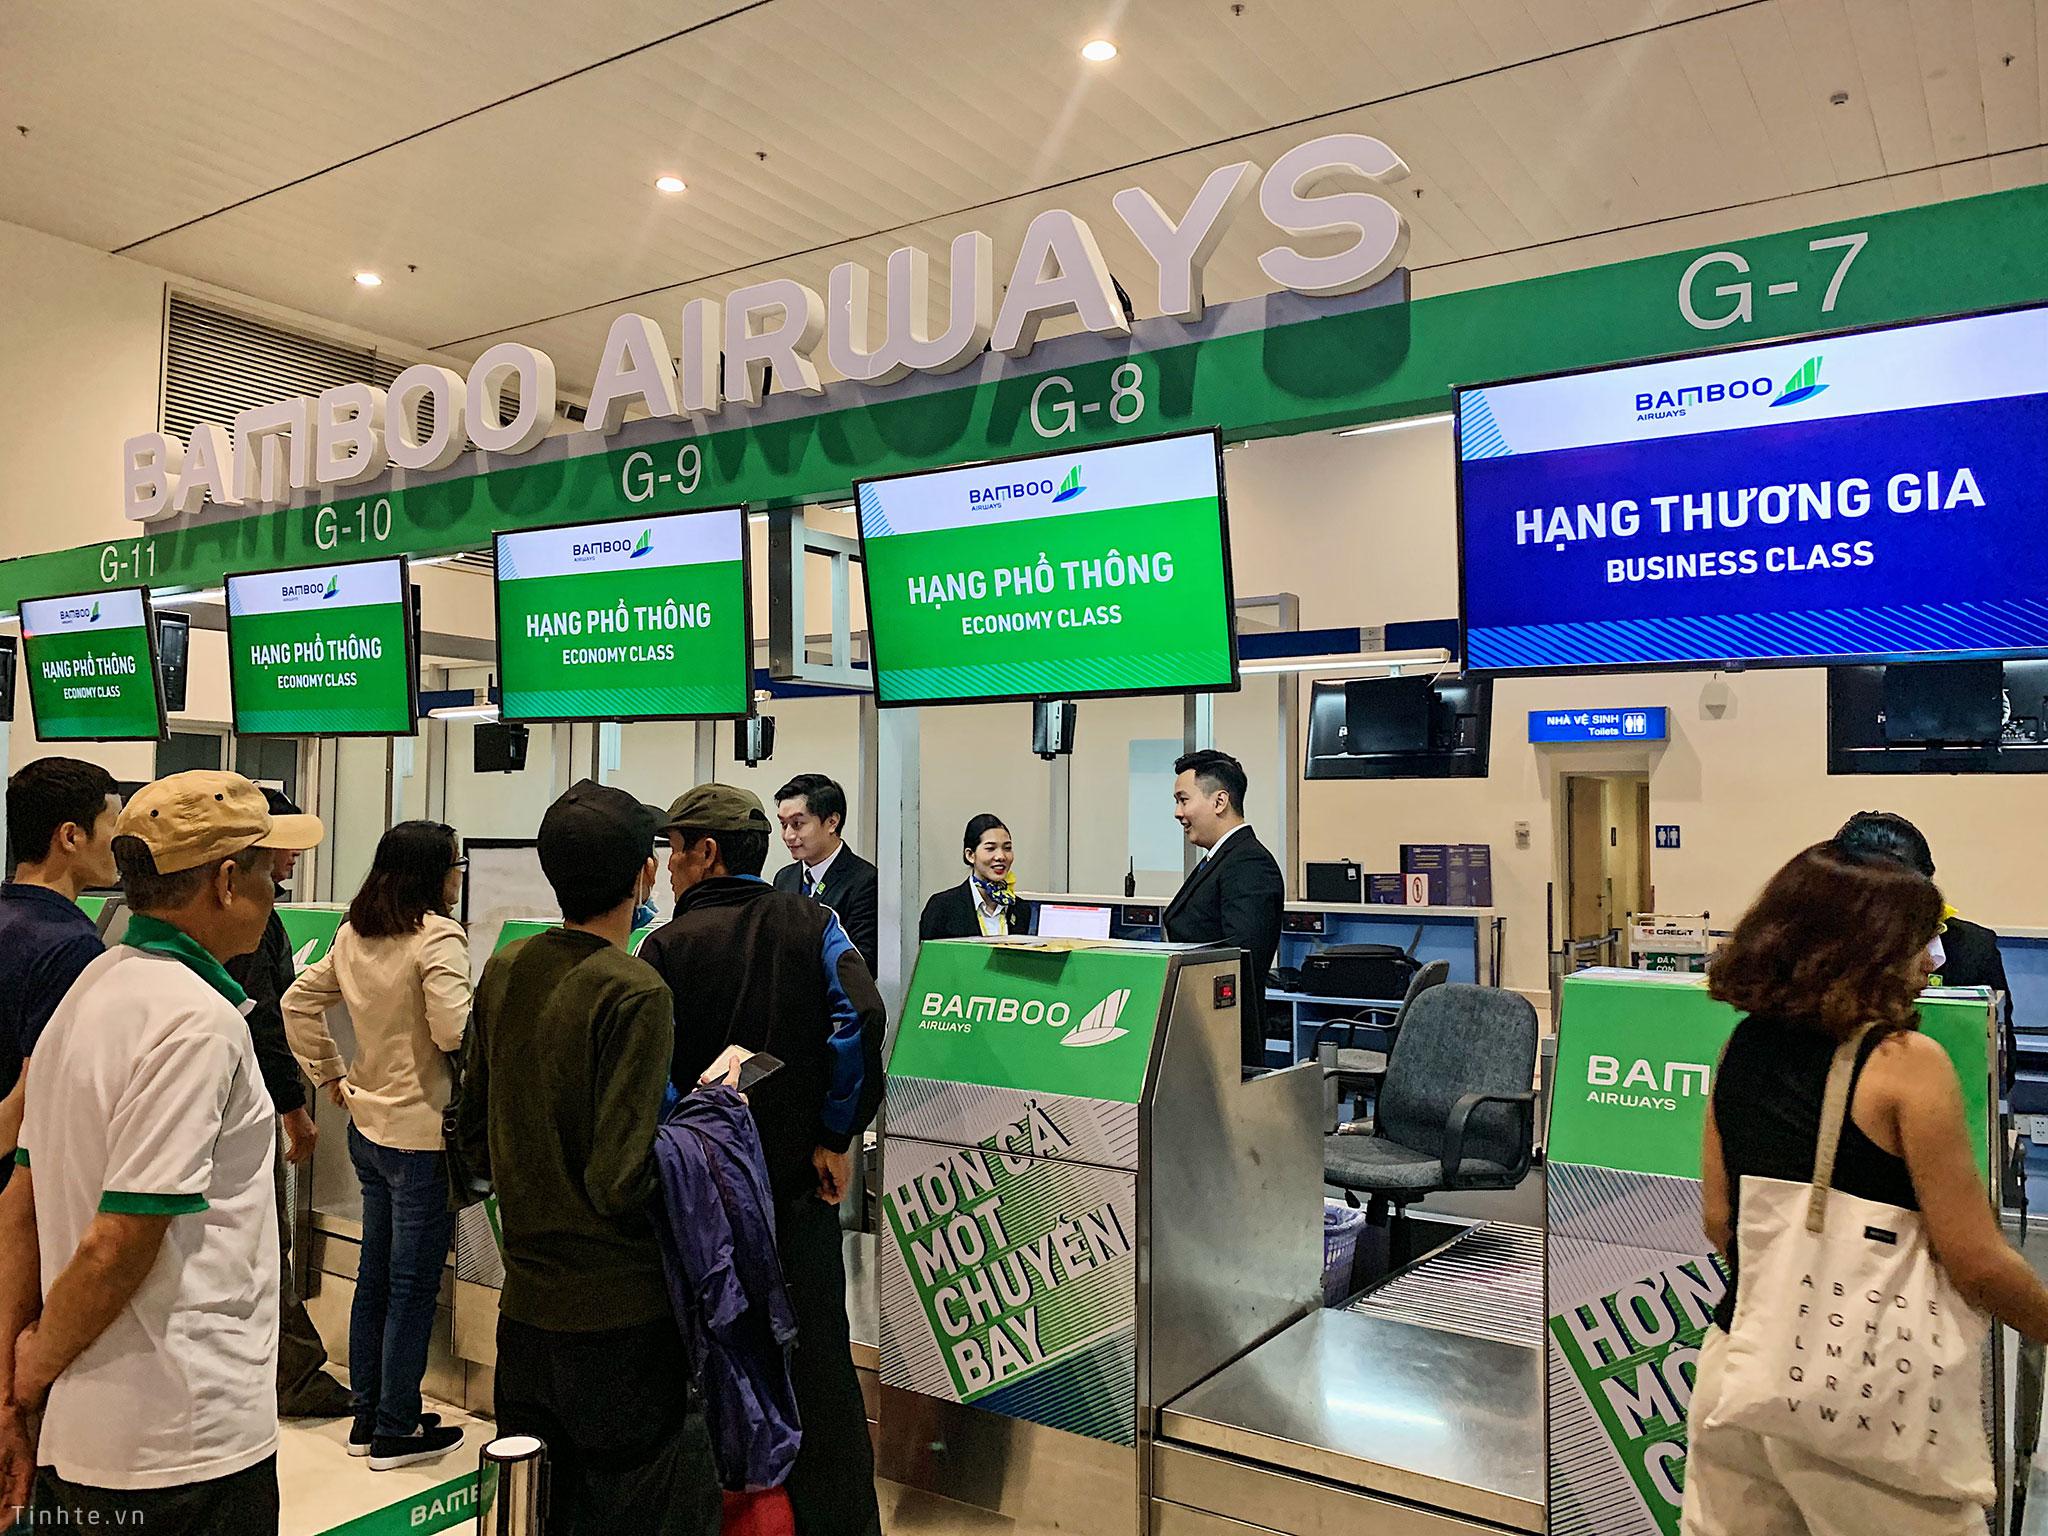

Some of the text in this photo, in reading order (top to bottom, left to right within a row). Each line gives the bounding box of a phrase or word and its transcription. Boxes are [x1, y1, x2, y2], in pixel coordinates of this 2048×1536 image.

[1678, 232, 1868, 330] G-7
[123, 133, 1409, 521] BAMBOO AIRWAYS
[1029, 363, 1145, 438] G-8
[1636, 376, 1773, 411] BAMBOO
[1637, 409, 1687, 421] AIRWAYS
[622, 443, 702, 502] G-9
[969, 479, 1054, 504] BAMBOO
[314, 498, 393, 551] G-10
[1516, 468, 1985, 551] HẠNG THƯƠNG GIA
[100, 540, 157, 583] G-11
[572, 539, 632, 556] BAMBOO
[1606, 540, 1875, 583] BUSINESS CLASS
[281, 583, 324, 597] BAMBOO
[908, 549, 1174, 610] HẠNG PHỔ THÔNG
[526, 597, 712, 643] HẠNG PHỔ THÔNG
[962, 604, 1122, 635] ECONOMY CLASS
[42, 651, 136, 683] HẠNG PHỔ THÔNG
[250, 632, 382, 670] HẠNG PHỔ THÔNG
[562, 644, 675, 665] ECONOMY CLASS
[63, 685, 121, 699] ECONOMY CLASS
[277, 672, 358, 689] ECONOMY CLASS
[1546, 713, 1619, 727] NHÀ VỆ SINH
[1588, 727, 1619, 736] Toilets
[1656, 928, 1694, 936] CREDIT
[918, 1019, 972, 1034] AIRWAYS
[921, 992, 1070, 1028] BAMBOO
[1586, 1091, 1677, 1112] AIRWAYS
[891, 1098, 1072, 1236] HƠN CẢ
[910, 1193, 1012, 1288] MỘT
[934, 1203, 1132, 1338] CHUYẾN
[1563, 1253, 1729, 1370] HƠN
[1800, 1274, 1814, 1289] A
[1833, 1282, 1845, 1296] B
[1865, 1289, 1882, 1304] C
[1929, 1300, 1939, 1316] E
[1799, 1304, 1810, 1317] F
[1828, 1313, 1844, 1327] G
[1865, 1320, 1878, 1336] H
[951, 1305, 1048, 1395] BAY
[1795, 1335, 1944, 1379] L M N O P
[1789, 1366, 1942, 1413] Q R S T U
[1788, 1398, 1801, 1412] V
[1819, 1405, 1839, 1423] W
[1857, 1414, 1871, 1431] X
[1891, 1421, 1906, 1436] Y
